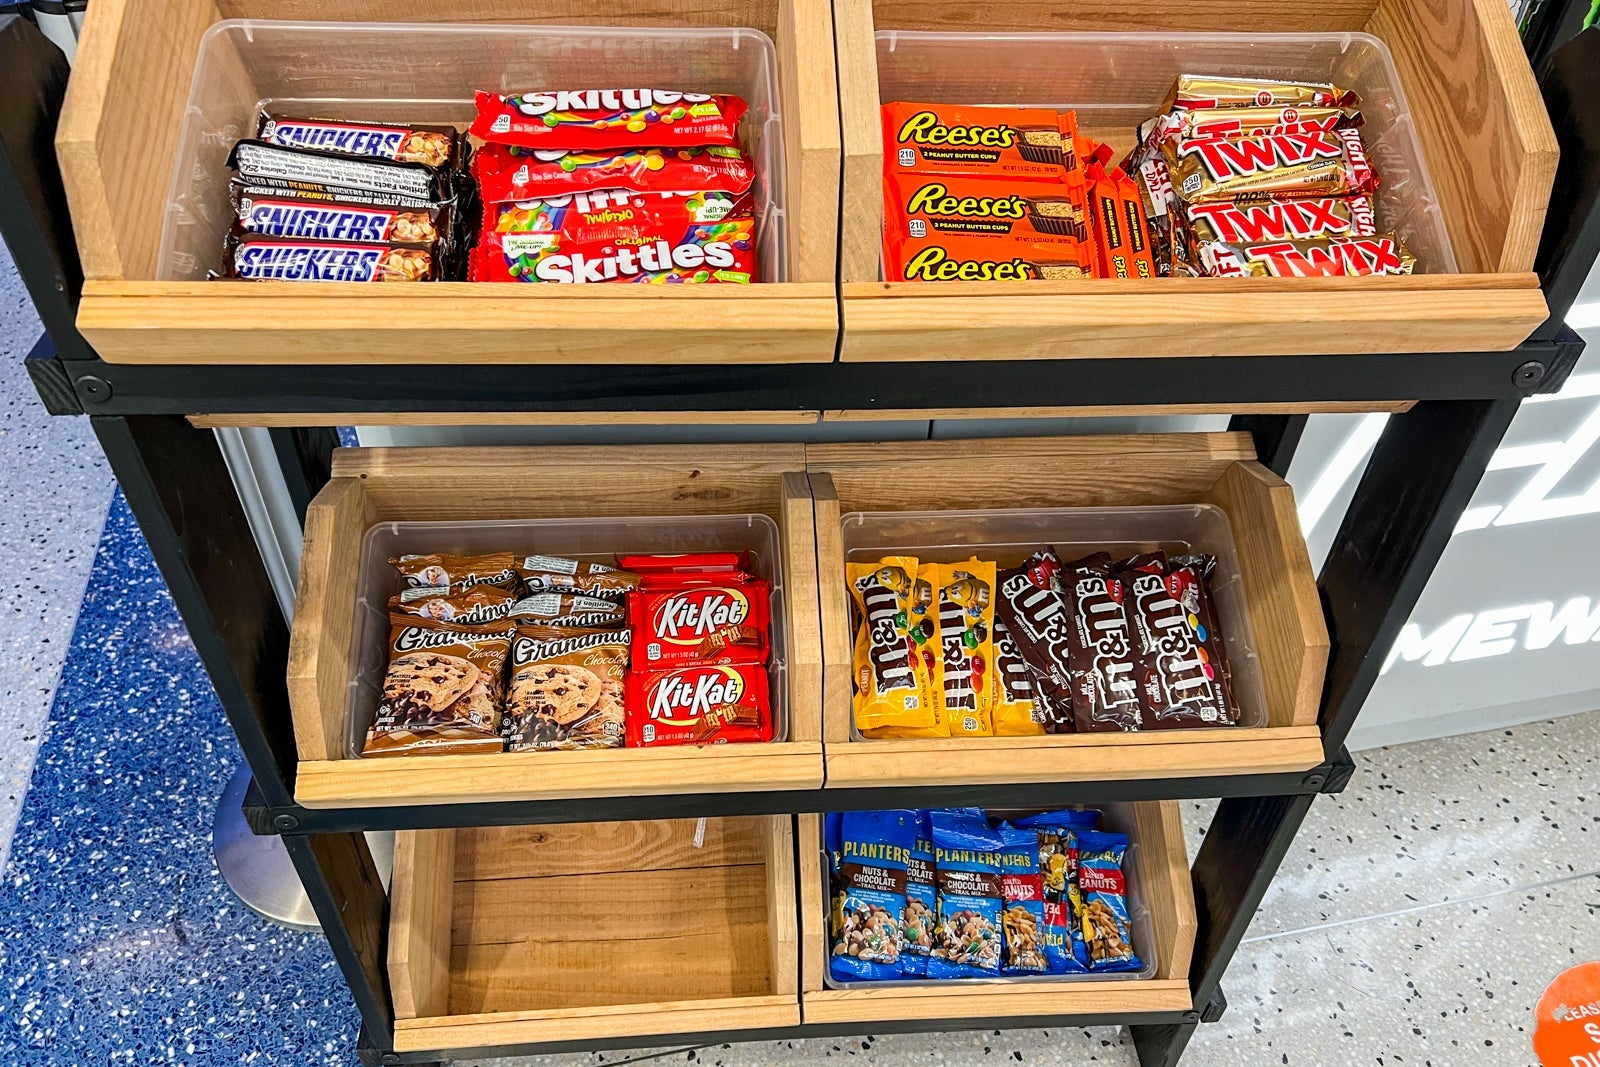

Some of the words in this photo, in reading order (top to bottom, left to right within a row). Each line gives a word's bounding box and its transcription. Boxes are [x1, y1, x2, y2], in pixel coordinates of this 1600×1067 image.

[898, 111, 1016, 147] Reese's
[274, 126, 402, 158] SNICKERS
[1339, 127, 1371, 170] RIGHT
[900, 150, 914, 158] 210
[260, 166, 287, 175] Calories
[267, 178, 288, 188] WITH
[374, 181, 397, 191] Facts
[1184, 174, 1200, 188] 250
[241, 200, 251, 209] 50
[243, 187, 274, 196] PACKED
[275, 189, 297, 197] WITH
[334, 194, 373, 204] SNICKERS
[373, 196, 399, 206] REALLY
[907, 183, 1026, 219] Reese's
[247, 206, 387, 240] SNICKERS
[1187, 198, 1351, 244] Twix
[1351, 196, 1377, 236] RIGH
[910, 221, 924, 229] 210
[1111, 226, 1119, 243] PEANUT
[1133, 230, 1141, 247] PEANUT
[238, 247, 379, 282] SNICKERS
[535, 240, 735, 283] Skittles
[904, 246, 1030, 281] Reese's
[1112, 255, 1128, 279] ese's
[1135, 258, 1150, 279] se's
[656, 595, 743, 638] KitKat
[467, 648, 506, 660] Chocola
[860, 668, 871, 694] PEANUT
[1049, 663, 1068, 690] CHOCOLATE
[1050, 673, 1060, 686] MILK
[650, 673, 738, 719] KitKat
[1080, 683, 1089, 695] MILK
[1144, 683, 1153, 695] MILK
[1150, 674, 1161, 703] CHOCOLATE
[604, 722, 618, 730] 340
[964, 717, 972, 730] 250
[843, 841, 911, 864] PLANTERS
[936, 847, 1002, 868] PLANTERS
[1003, 853, 1031, 868] NTERS
[862, 866, 882, 876] NUTS
[882, 869, 888, 877] &
[907, 859, 920, 869] UTS
[920, 861, 926, 869] &
[853, 873, 896, 888] CHOCOLATE
[907, 867, 934, 880] COLATE
[975, 874, 982, 882] &
[947, 880, 990, 892] CHOCOLATE
[1080, 879, 1118, 890] EANUTS
[1044, 903, 1061, 915] PEA
